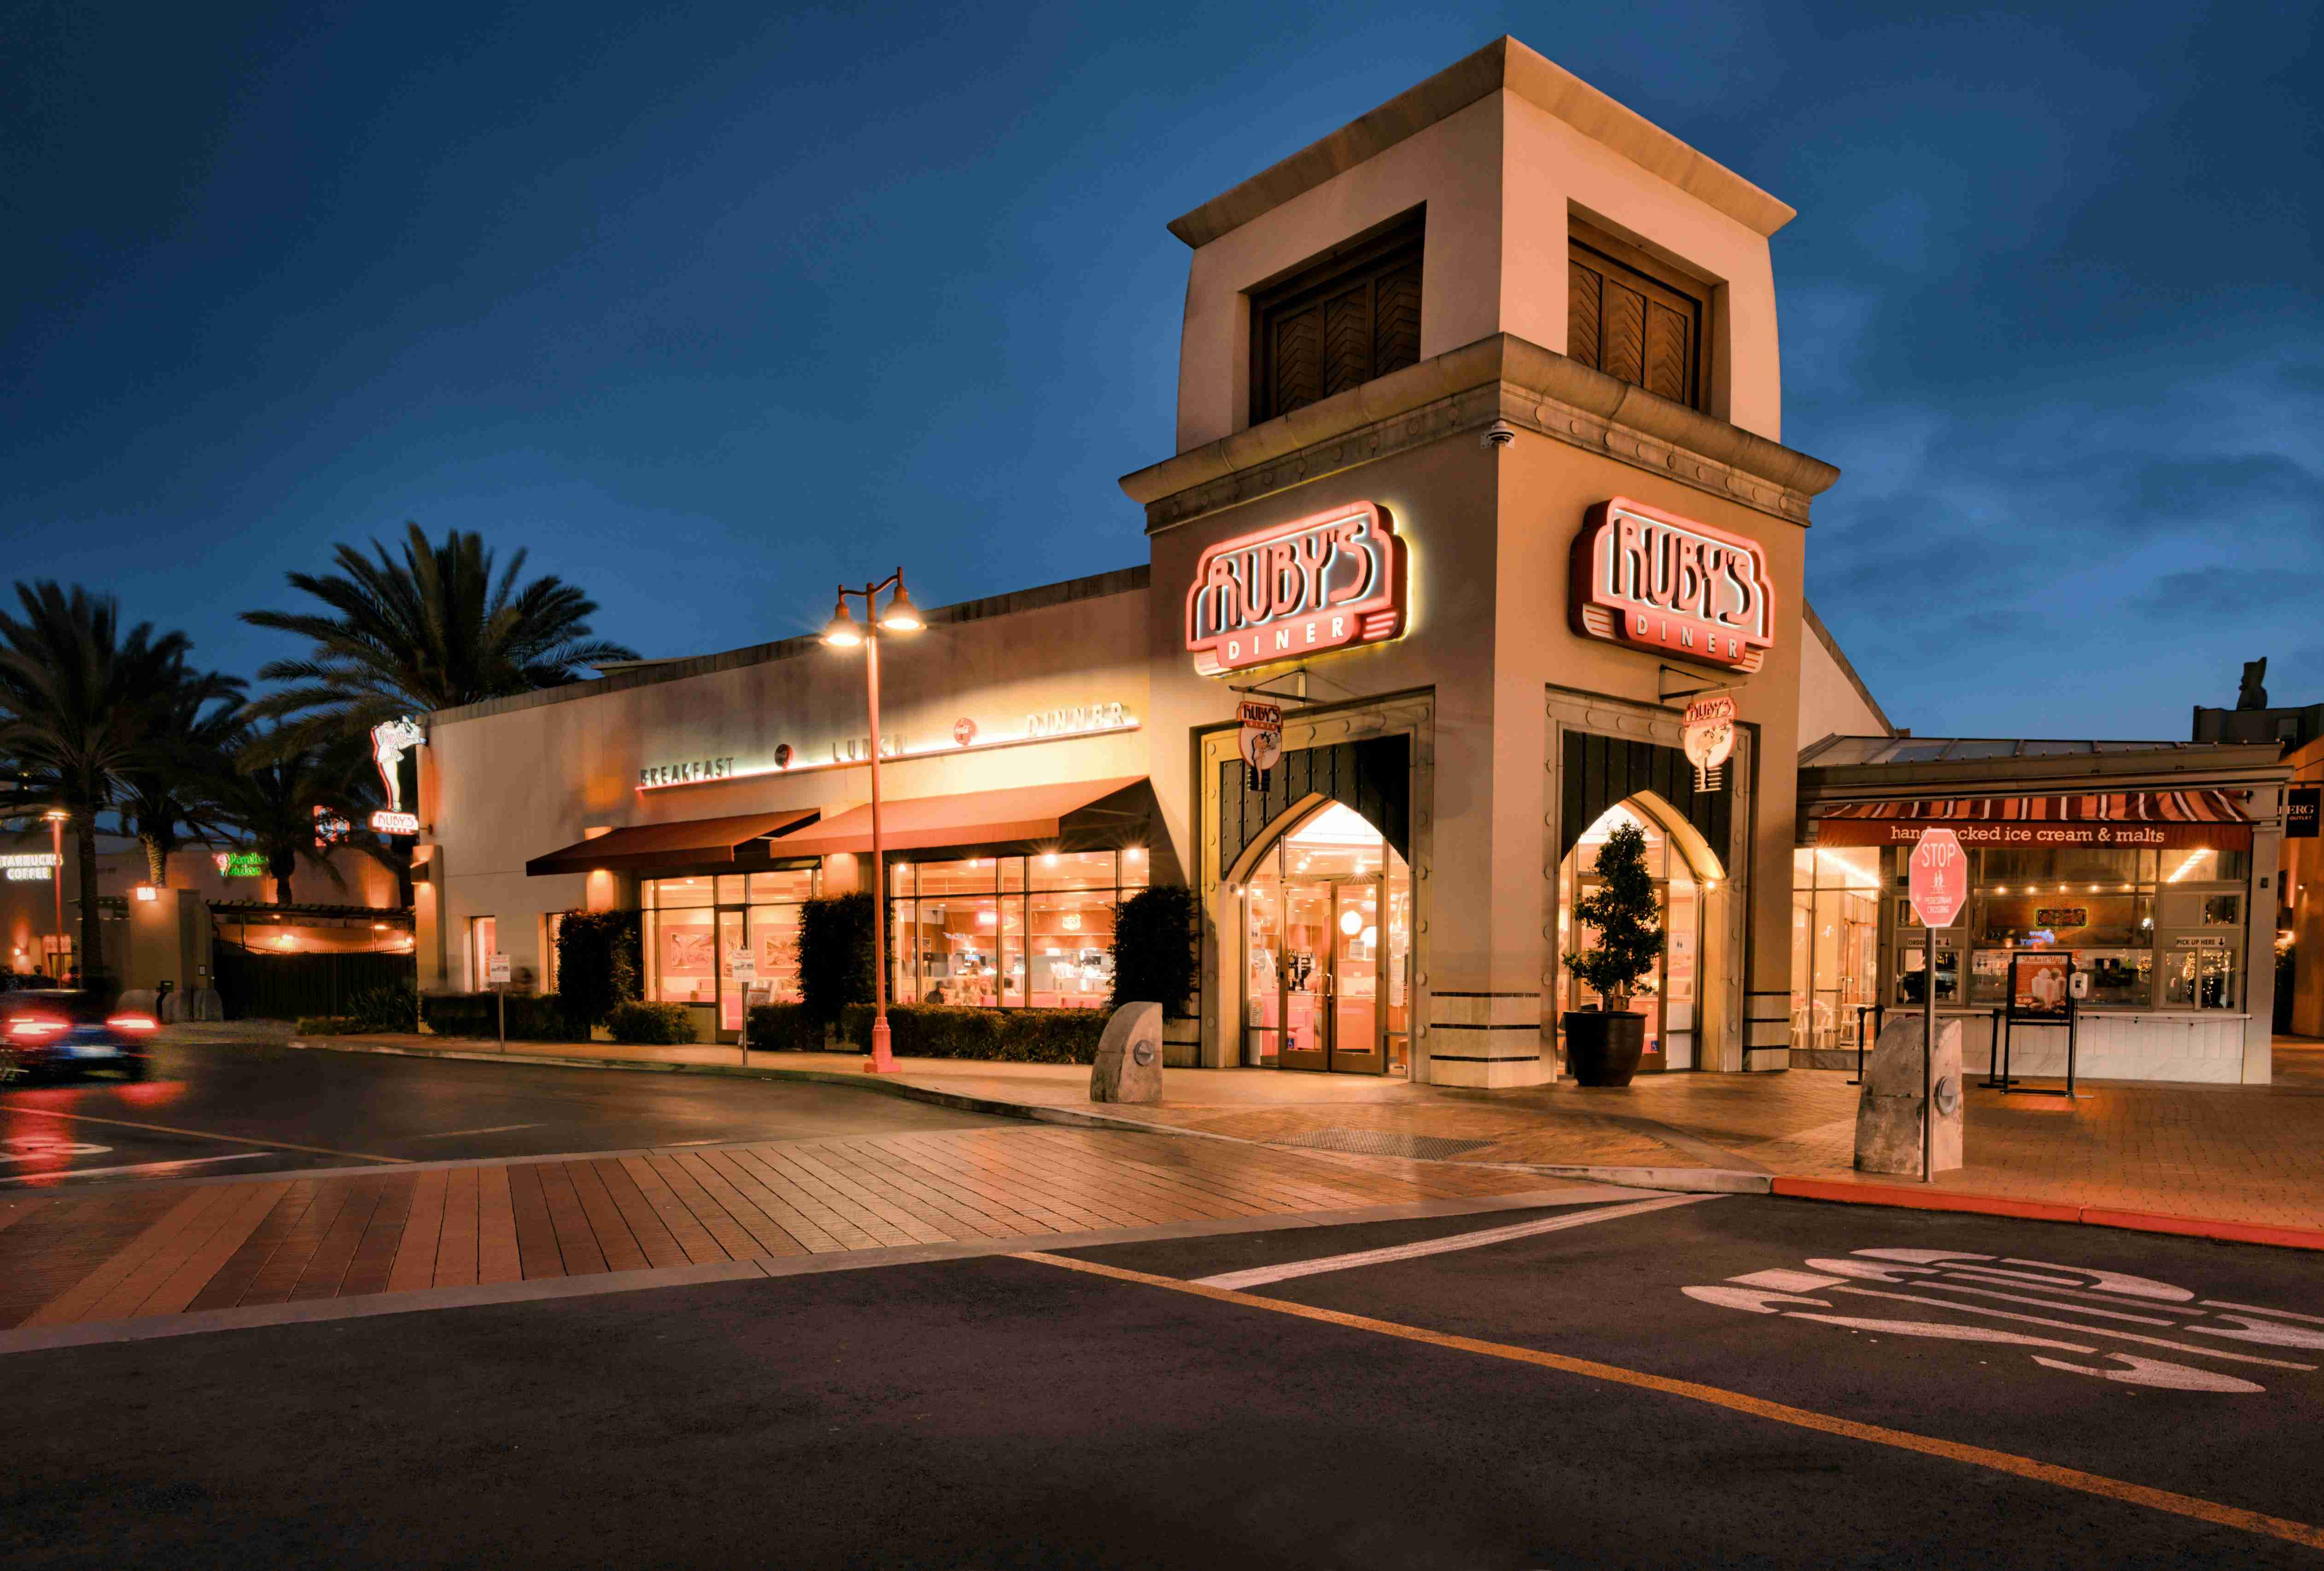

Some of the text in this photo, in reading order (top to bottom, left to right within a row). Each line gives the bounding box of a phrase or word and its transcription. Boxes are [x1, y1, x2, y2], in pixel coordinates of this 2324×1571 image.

[1209, 522, 1370, 631] RUBY'S
[1614, 518, 1757, 625] RUBY'S
[1228, 617, 1344, 660] DINER
[1636, 614, 1738, 658] DINER
[1027, 702, 1127, 737] DINNER
[1244, 704, 1279, 722] RUBY'S
[1687, 699, 1731, 722] RUBY'S
[640, 757, 735, 786] BREAKFAST
[2004, 827, 2032, 841] ice
[2037, 830, 2093, 842] cream
[2098, 827, 2111, 842] &
[2115, 827, 2165, 843] malts
[1922, 843, 1956, 867] STOP
[7, 867, 52, 880] COFFEE
